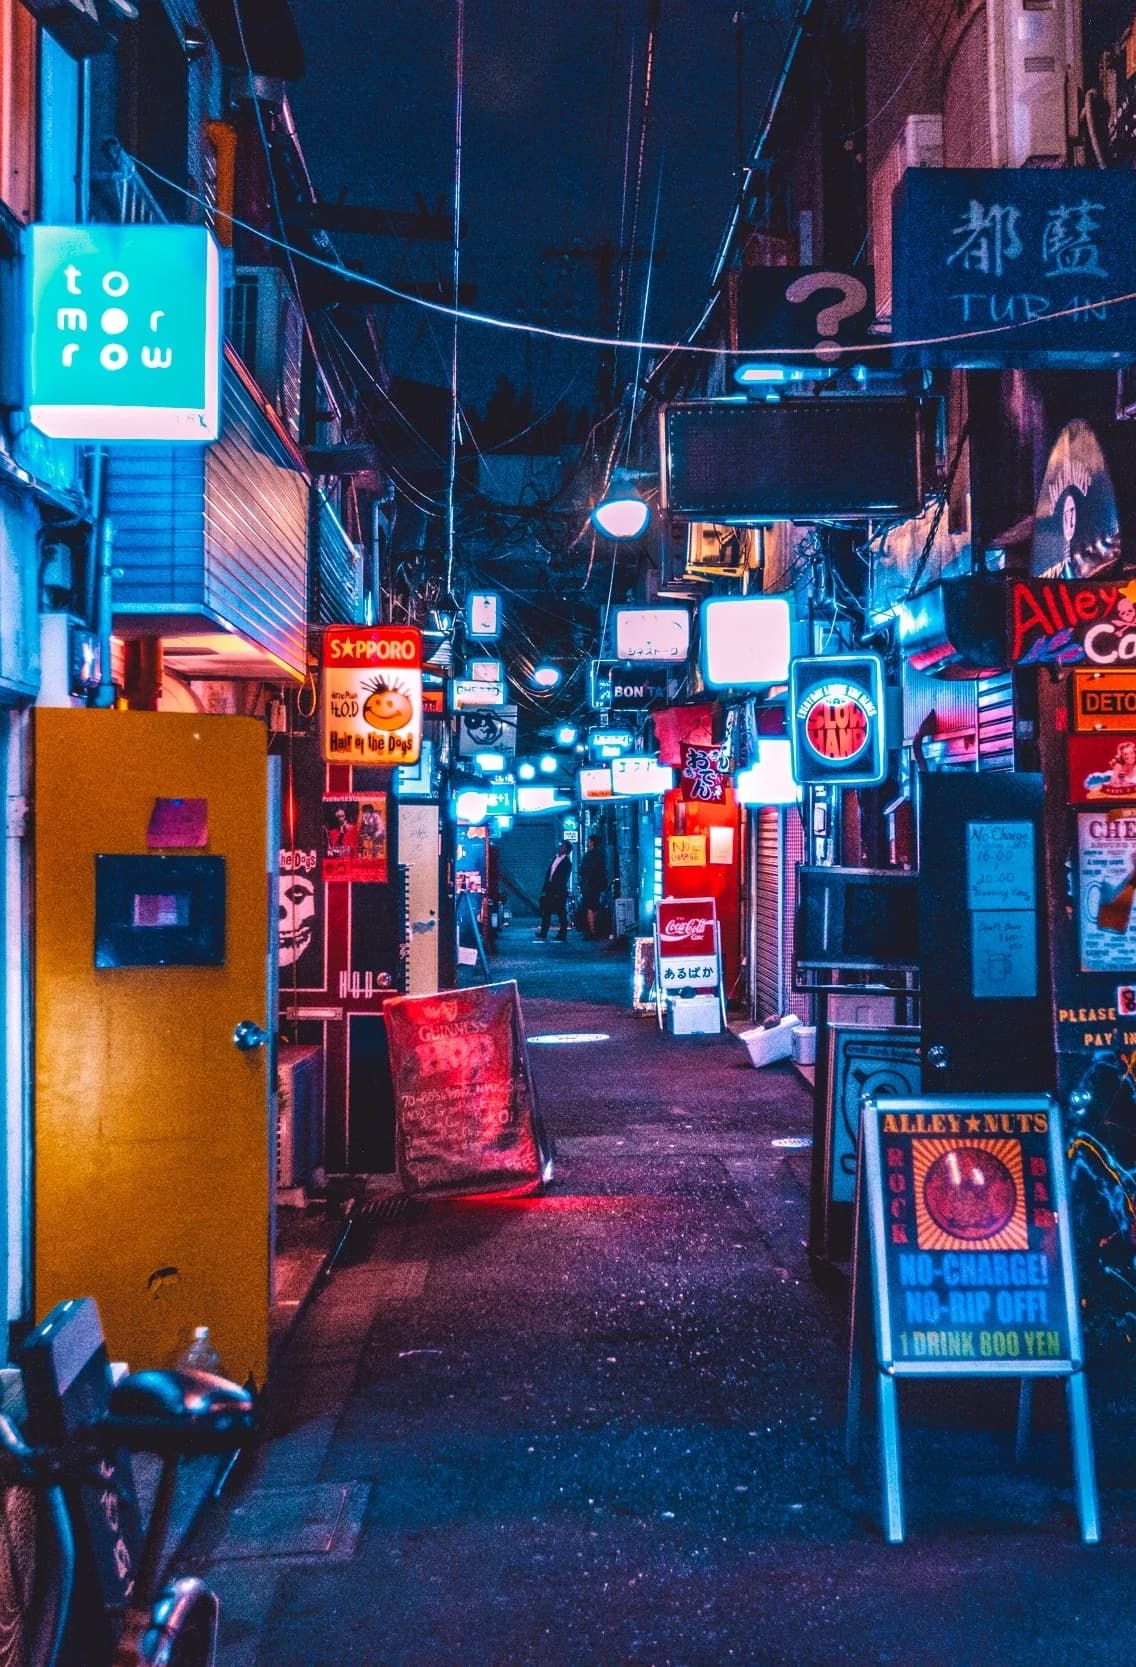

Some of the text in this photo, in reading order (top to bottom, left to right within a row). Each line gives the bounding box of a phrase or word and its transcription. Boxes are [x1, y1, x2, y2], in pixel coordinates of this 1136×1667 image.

[1012, 582, 1118, 660] Alley
[330, 731, 412, 756] Hair of the Dogs
[686, 747, 714, 800] おでん
[1058, 1007, 1117, 1023] PLEASE
[1083, 1032, 1113, 1046] PAY
[898, 1252, 1049, 1287] NO-CHARGE!
[905, 1290, 1049, 1324] NO-RIP OFF!
[912, 1330, 975, 1357] DRINK
[1023, 1330, 1061, 1357] YEN
